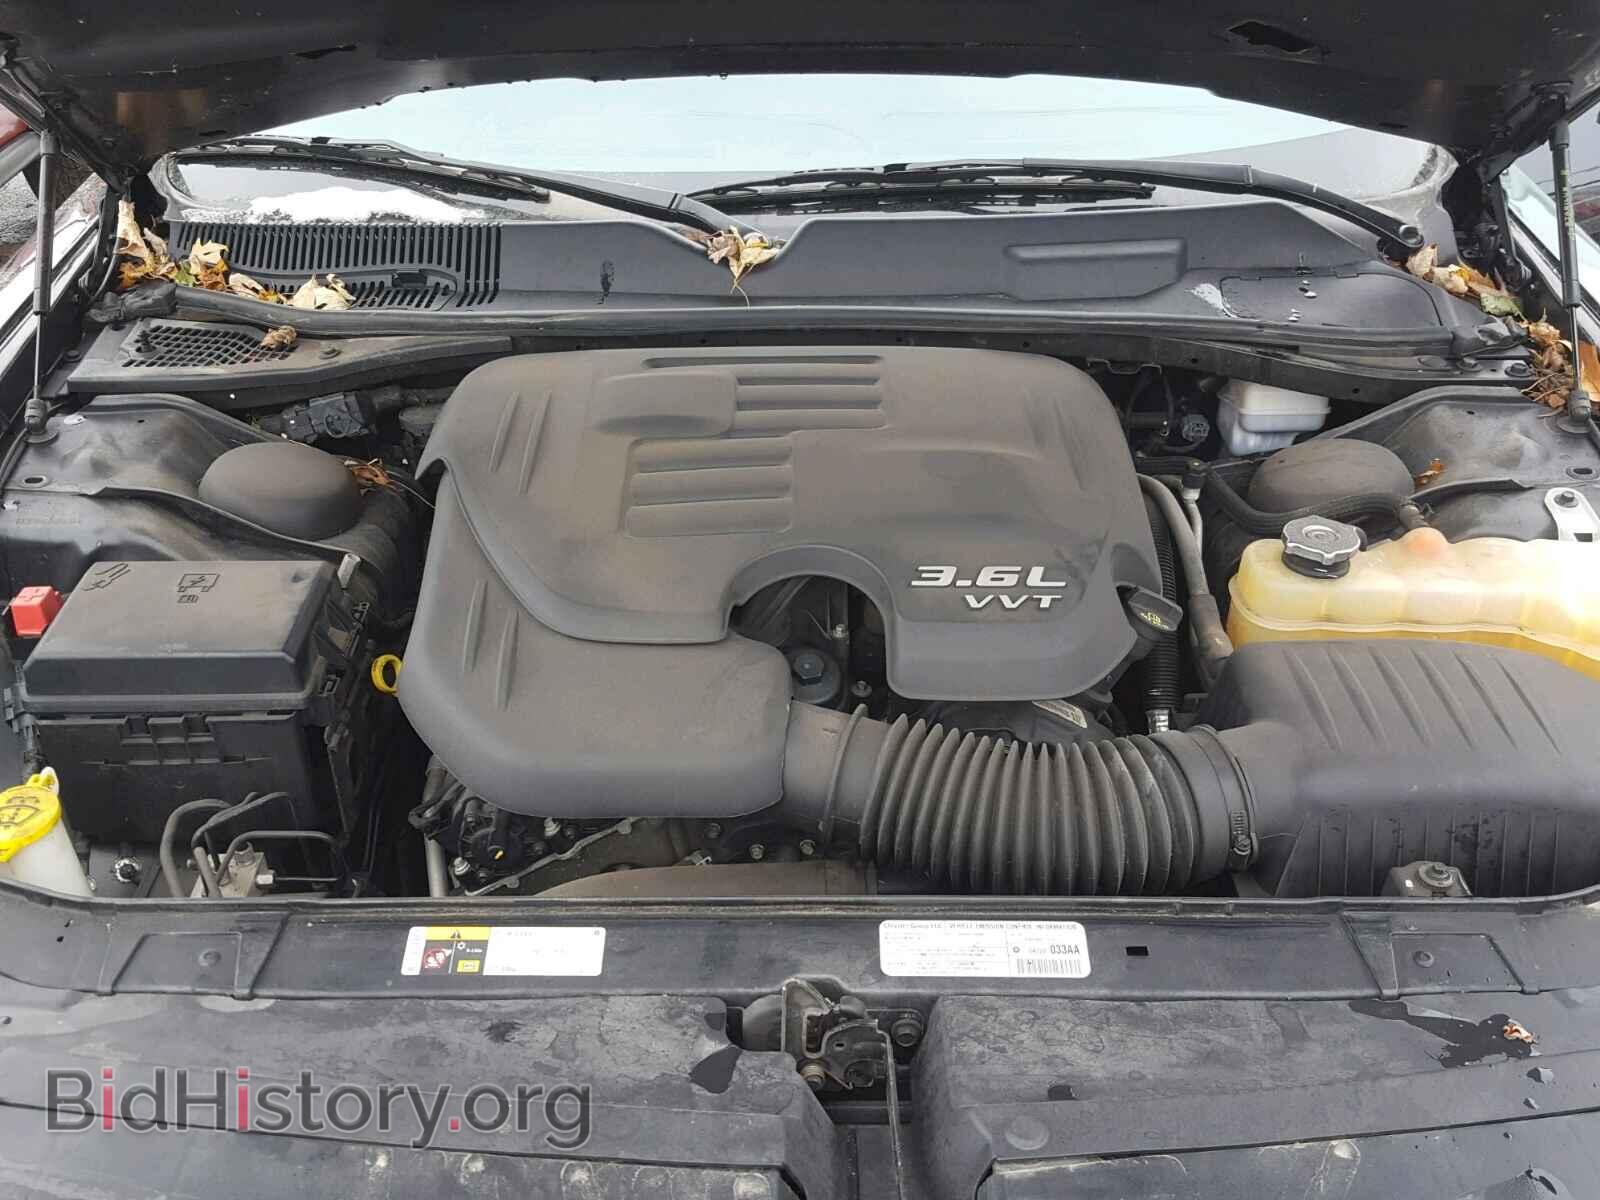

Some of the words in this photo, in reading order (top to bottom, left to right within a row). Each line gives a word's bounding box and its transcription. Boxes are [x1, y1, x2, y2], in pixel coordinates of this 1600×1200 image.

[911, 565, 1066, 587] 3.6L
[964, 594, 1063, 609] VVT
[1050, 944, 1080, 955] 033AA
